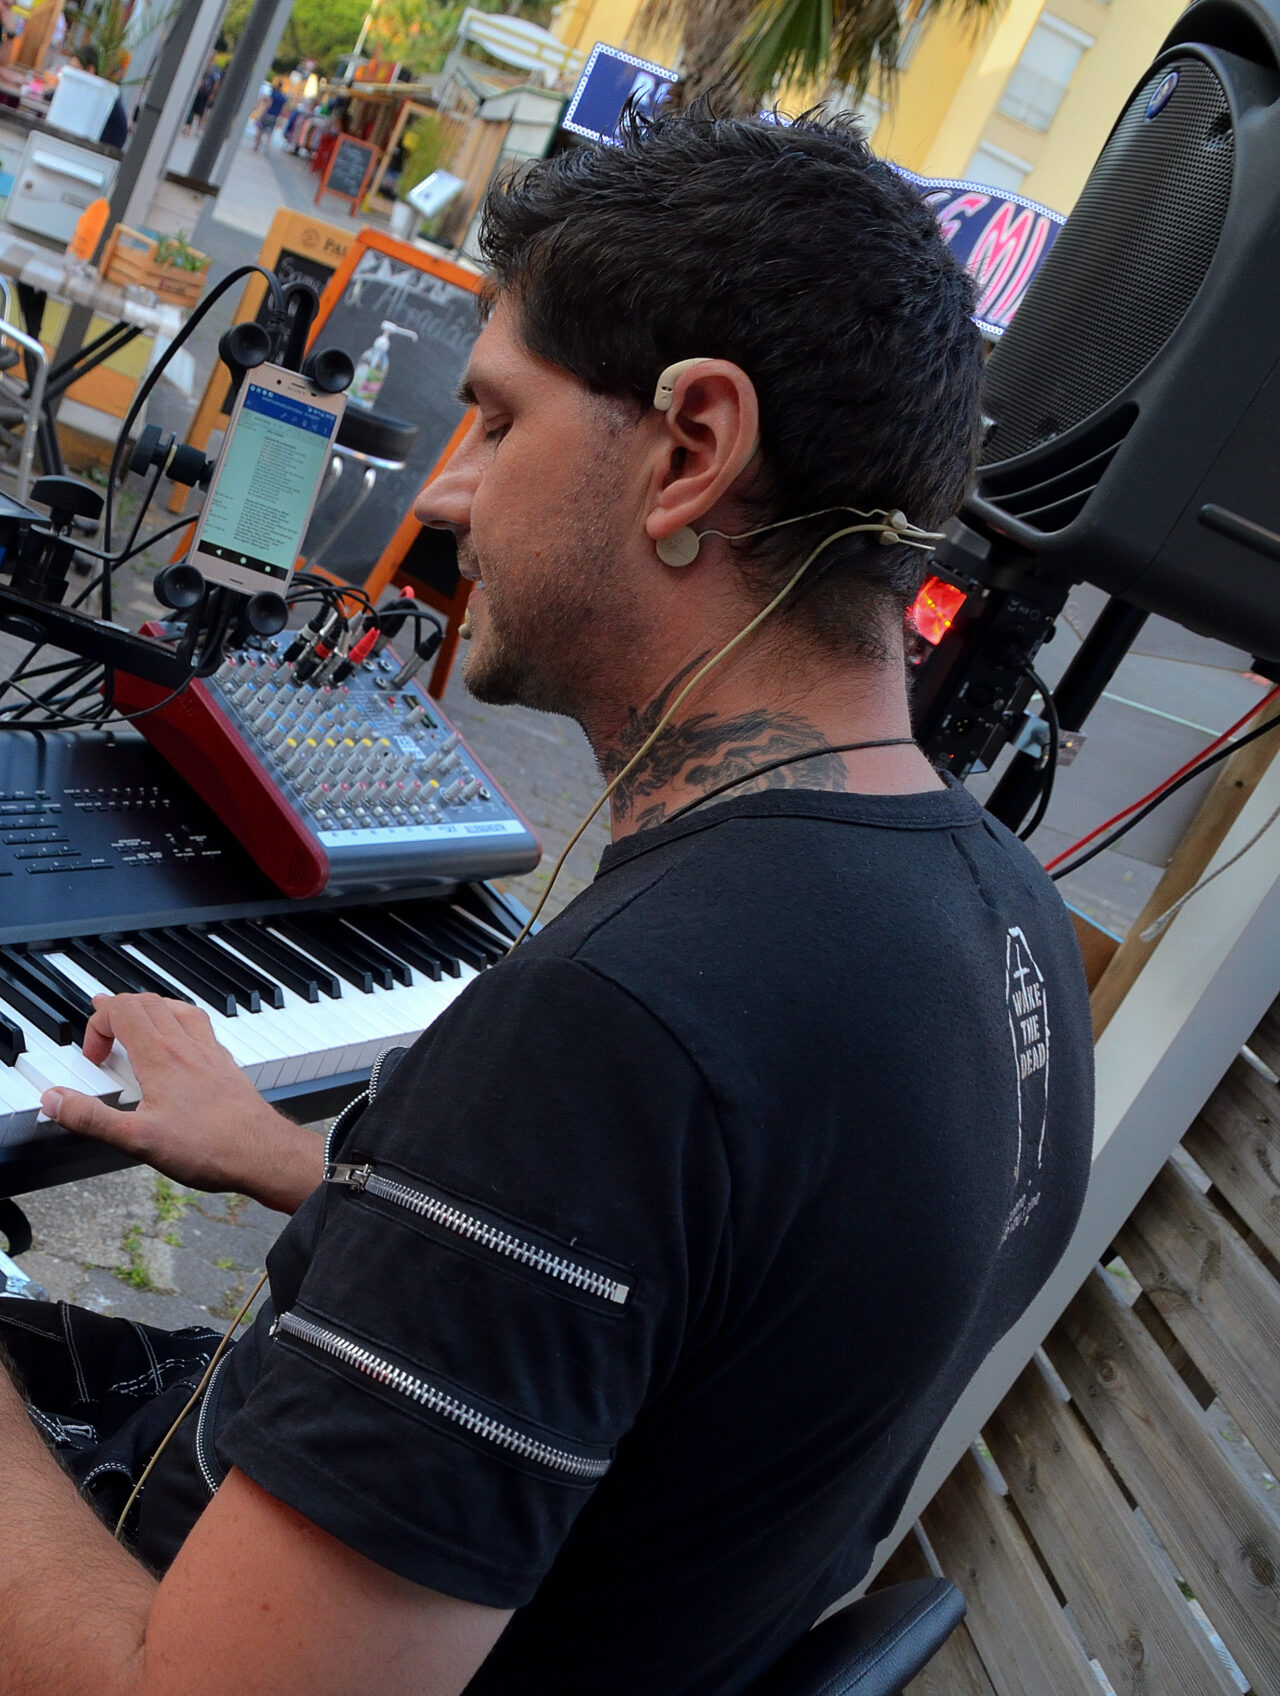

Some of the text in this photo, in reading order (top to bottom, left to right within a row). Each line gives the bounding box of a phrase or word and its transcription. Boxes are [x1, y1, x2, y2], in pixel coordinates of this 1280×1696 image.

[1012, 982, 1042, 1017] WAKE
[1020, 1014, 1040, 1046] THE
[1020, 1042, 1046, 1080] DEAD
